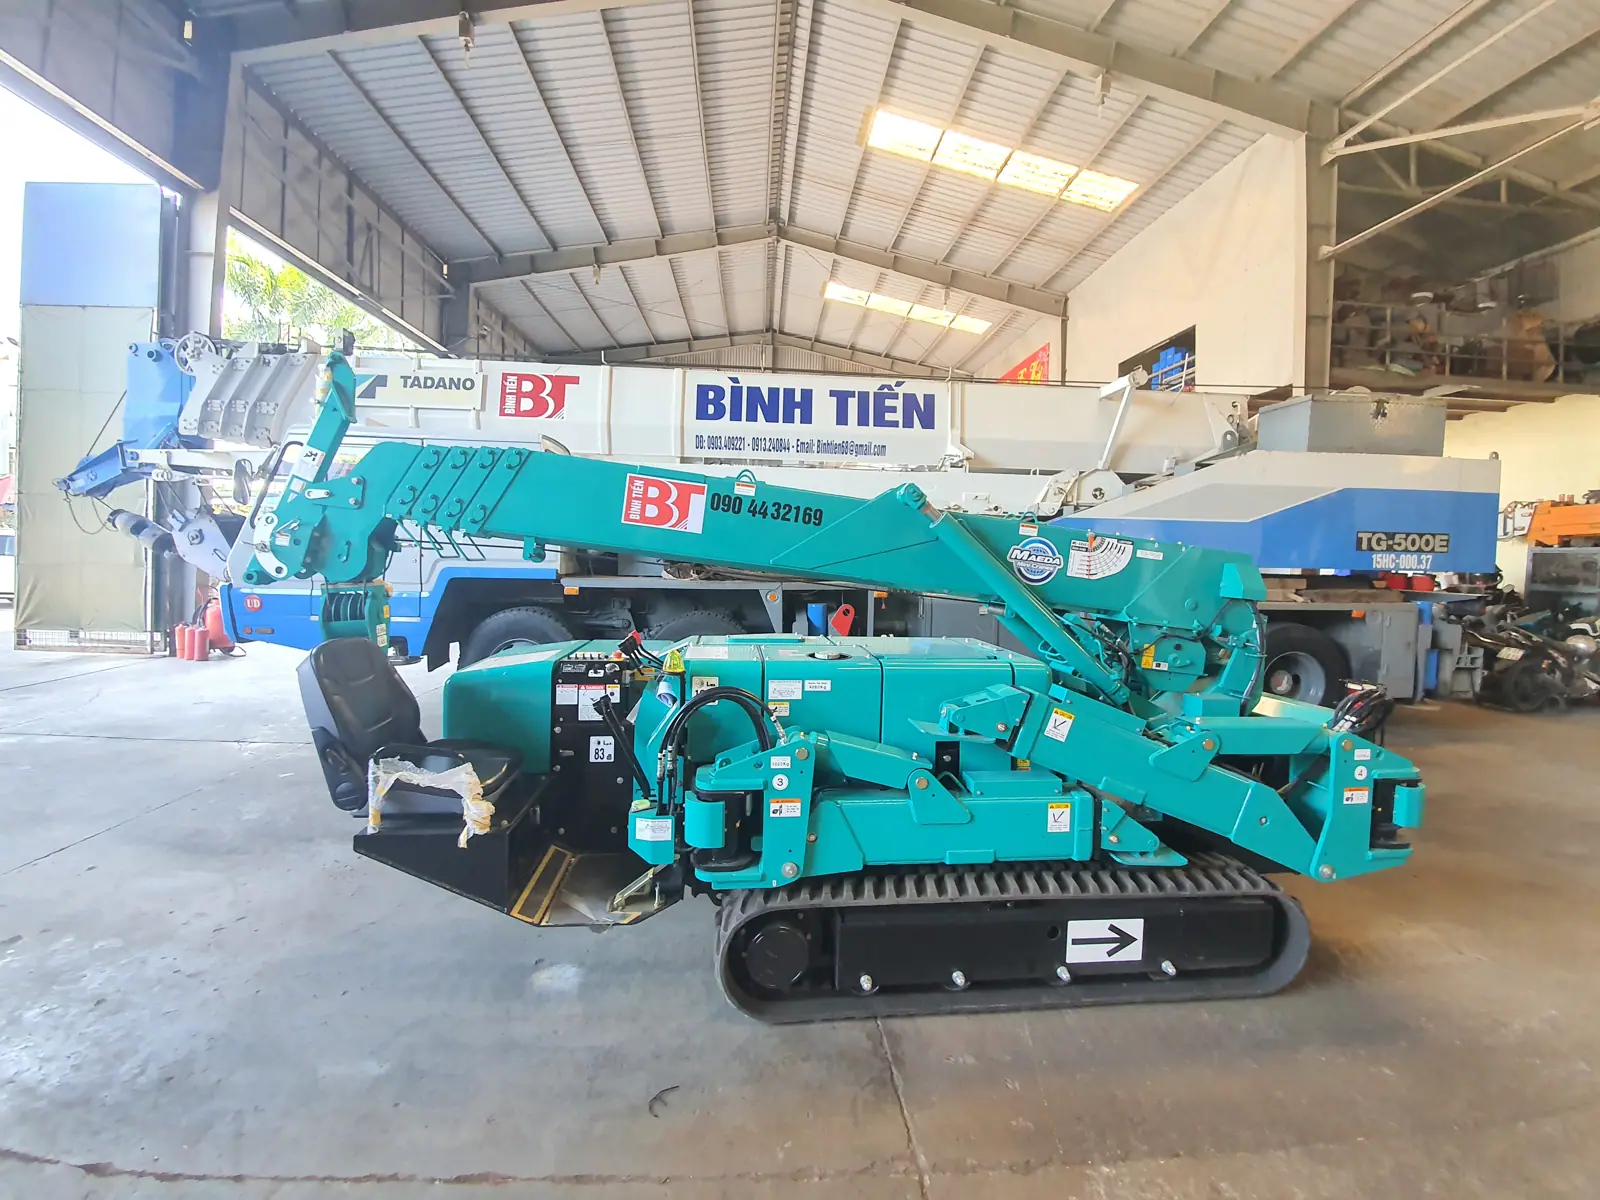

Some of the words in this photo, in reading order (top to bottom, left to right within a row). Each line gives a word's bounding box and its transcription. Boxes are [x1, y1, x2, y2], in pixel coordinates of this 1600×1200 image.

[400, 375, 475, 391] TADANO
[695, 376, 813, 425] BÌNH
[829, 381, 936, 430] TIẾN
[706, 435, 746, 451] 0903.409221
[751, 436, 790, 453] 0913.240844
[796, 438, 815, 454] Email:
[816, 439, 887, 457] Binhtien68@gmail.com
[709, 493, 743, 515] 090
[1357, 532, 1449, 552] TG-500E
[1371, 553, 1433, 570] 15HC-000.37
[246, 598, 261, 609] UD
[594, 747, 605, 760] 83
[1357, 769, 1363, 777] 4
[777, 777, 784, 787] 3
